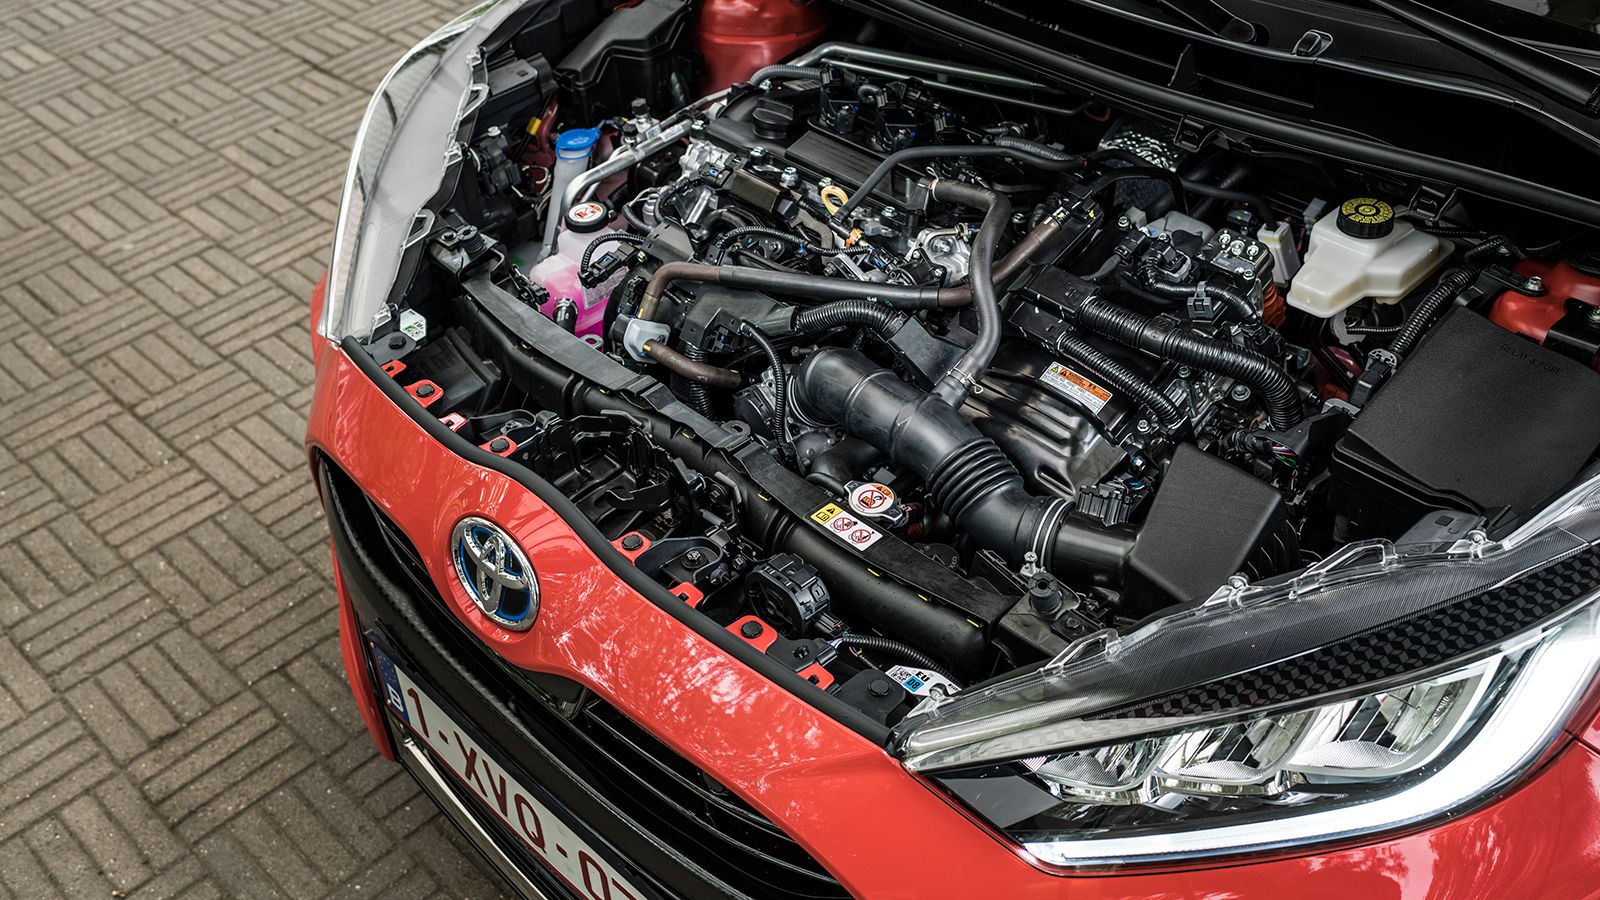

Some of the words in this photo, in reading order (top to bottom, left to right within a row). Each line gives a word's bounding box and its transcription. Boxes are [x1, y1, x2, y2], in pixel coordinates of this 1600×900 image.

[915, 671, 931, 682] EU
[388, 686, 404, 713] B
[407, 687, 638, 900] 1-XVQ-0
